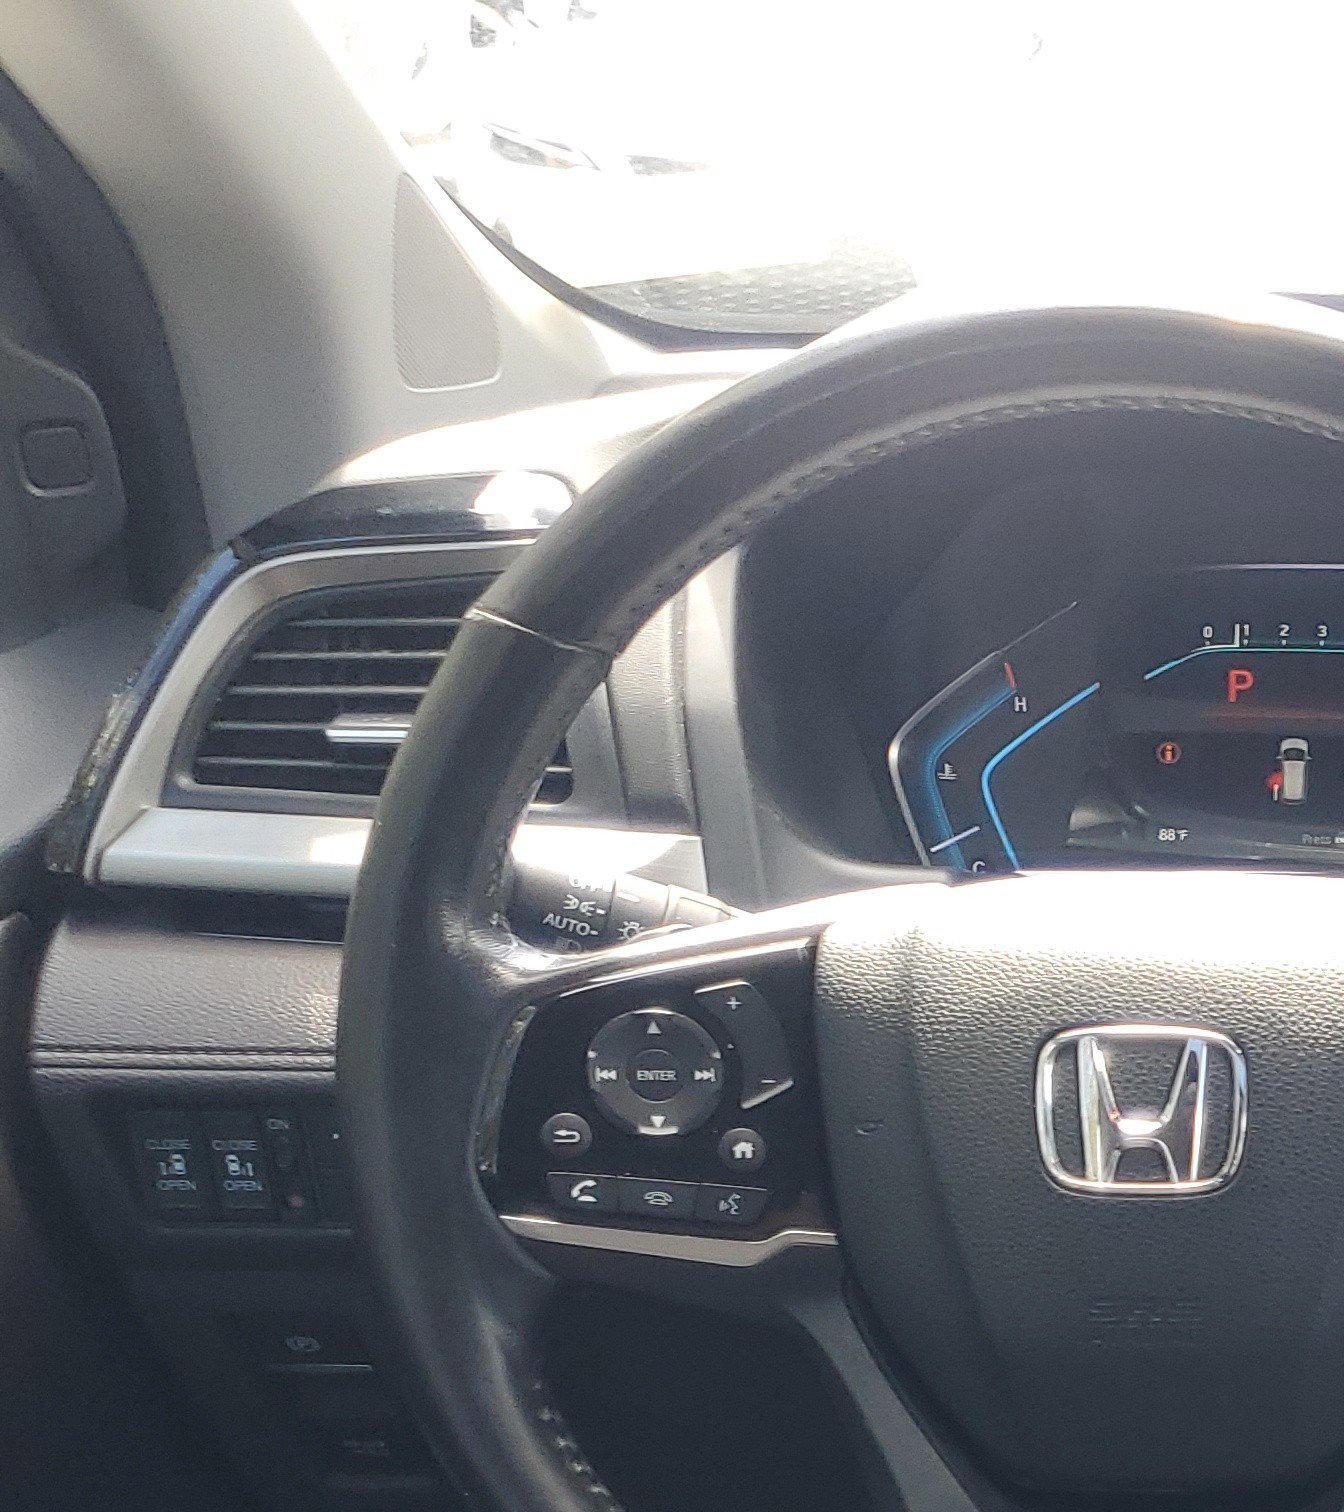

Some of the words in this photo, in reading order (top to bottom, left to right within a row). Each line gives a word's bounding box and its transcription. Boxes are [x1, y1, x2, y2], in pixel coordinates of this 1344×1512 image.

[1203, 625, 1214, 639] 0
[1279, 624, 1290, 637] 2
[1317, 624, 1328, 637] 3
[1227, 669, 1255, 702] P
[1014, 697, 1027, 712] H
[636, 1069, 678, 1082] ENTER
